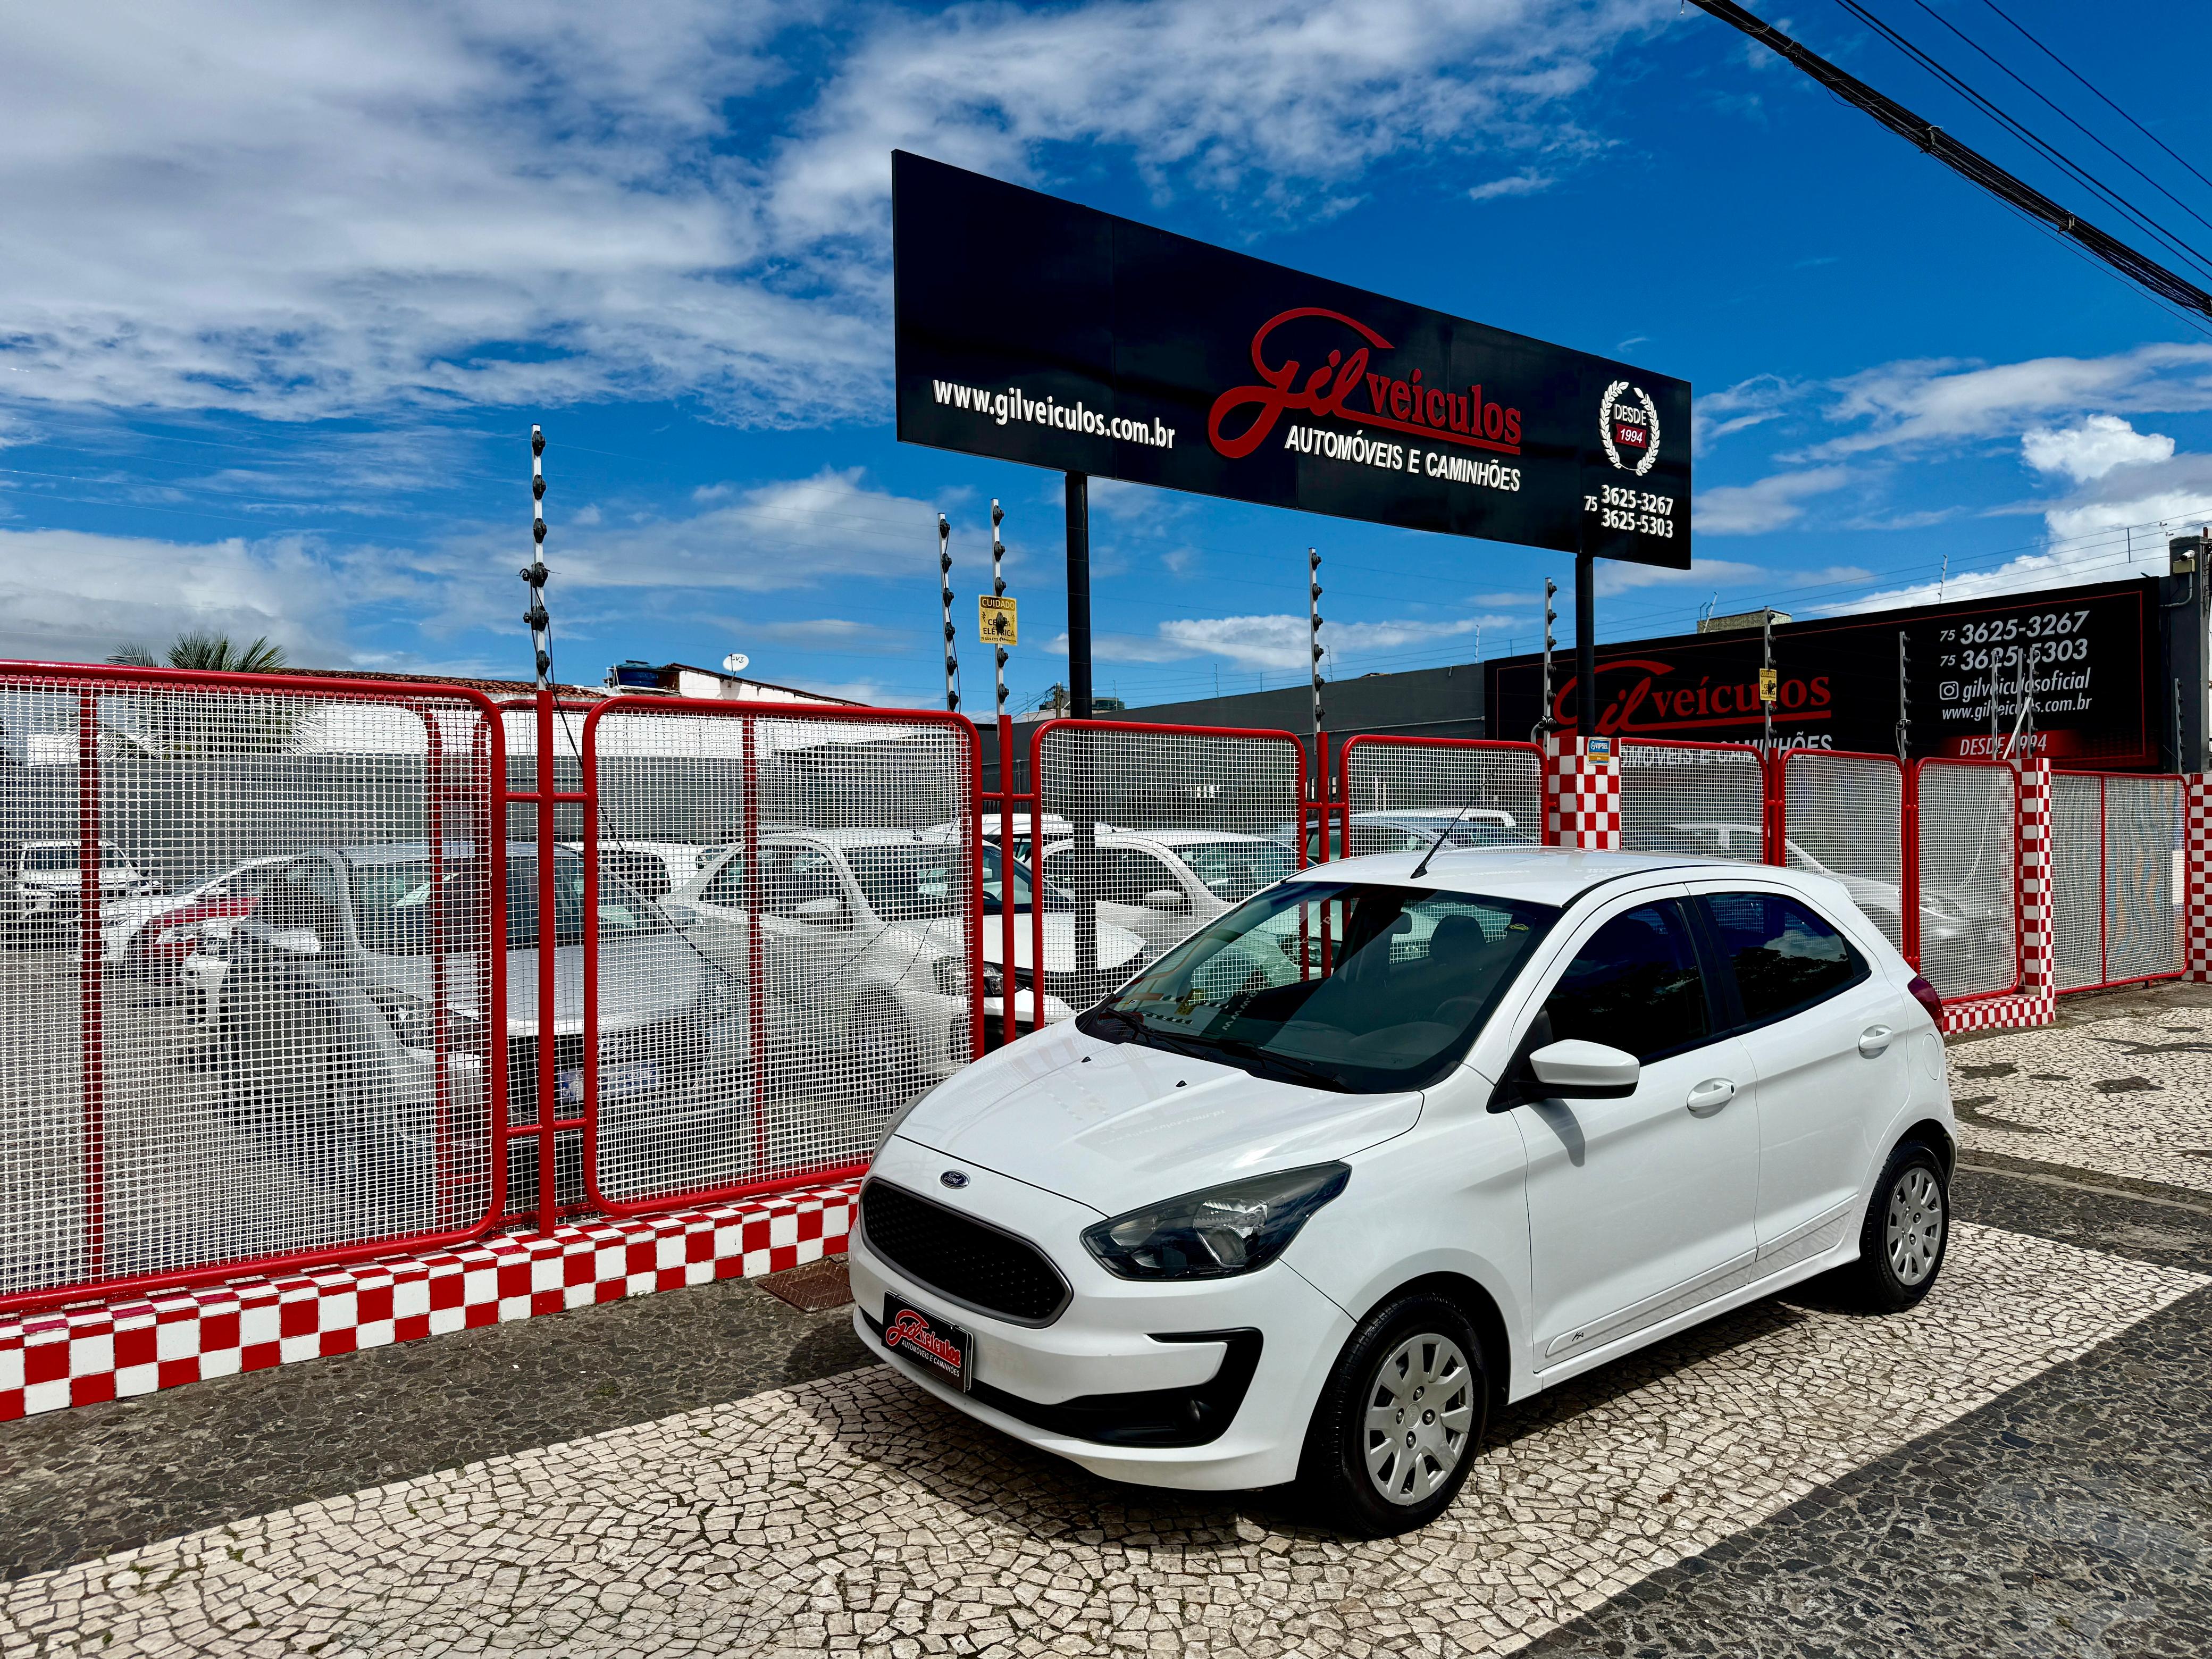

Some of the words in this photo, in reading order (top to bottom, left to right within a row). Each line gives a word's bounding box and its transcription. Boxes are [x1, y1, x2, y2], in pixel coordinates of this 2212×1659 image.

[932, 379, 1175, 449] www.gilveiculos.com.br
[1613, 404, 1647, 426] DESDE
[1620, 428, 1643, 443] 1994
[1284, 424, 1403, 470] AUTOMÓVEIS
[1407, 449, 1420, 474] E
[1426, 451, 1521, 492] CAMINHÕES
[1583, 495, 1598, 512] 75
[1601, 484, 1673, 516] 3625-3267
[1601, 508, 1673, 538] 3625-5303
[982, 599, 1015, 609] CUIDADO
[1940, 630, 1956, 642] 75
[1960, 610, 2090, 645] 3625-3267
[1940, 655, 1956, 667] 75
[1960, 638, 2088, 671] 36255303
[1652, 676, 1831, 717] veícuos
[944, 1172, 962, 1184] Ford
[901, 1339, 929, 1360] AUTOMÓVEIS
[933, 1357, 960, 1377] CAMINHÕES
